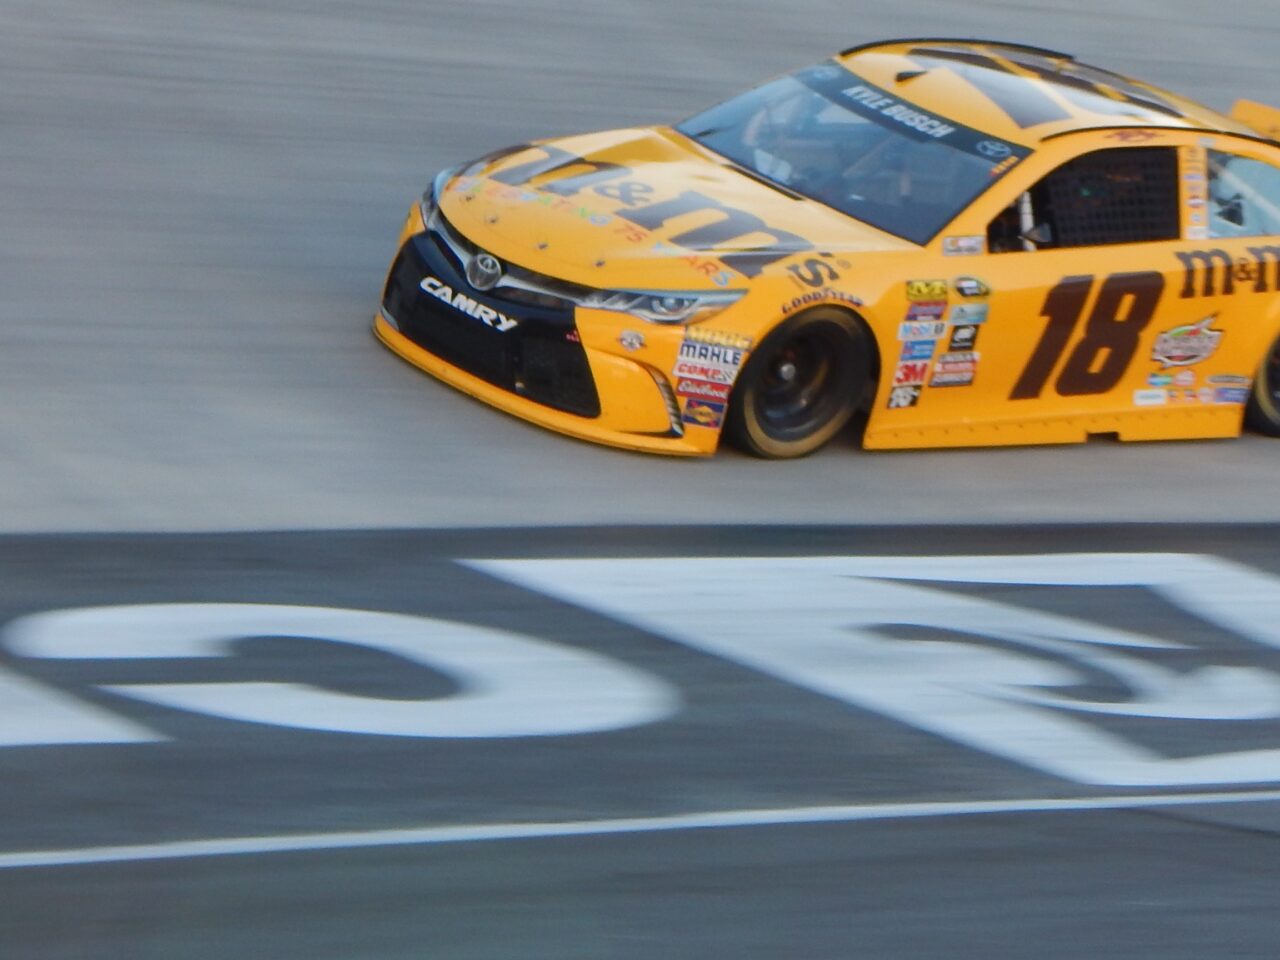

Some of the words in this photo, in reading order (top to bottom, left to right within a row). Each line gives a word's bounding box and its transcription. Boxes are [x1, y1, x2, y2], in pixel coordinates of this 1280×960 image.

[842, 85, 894, 110] KYLE
[881, 103, 956, 138] BUSCH
[420, 276, 518, 333] CAMRY
[681, 343, 742, 366] MAHLE
[1008, 270, 1165, 401] 18
